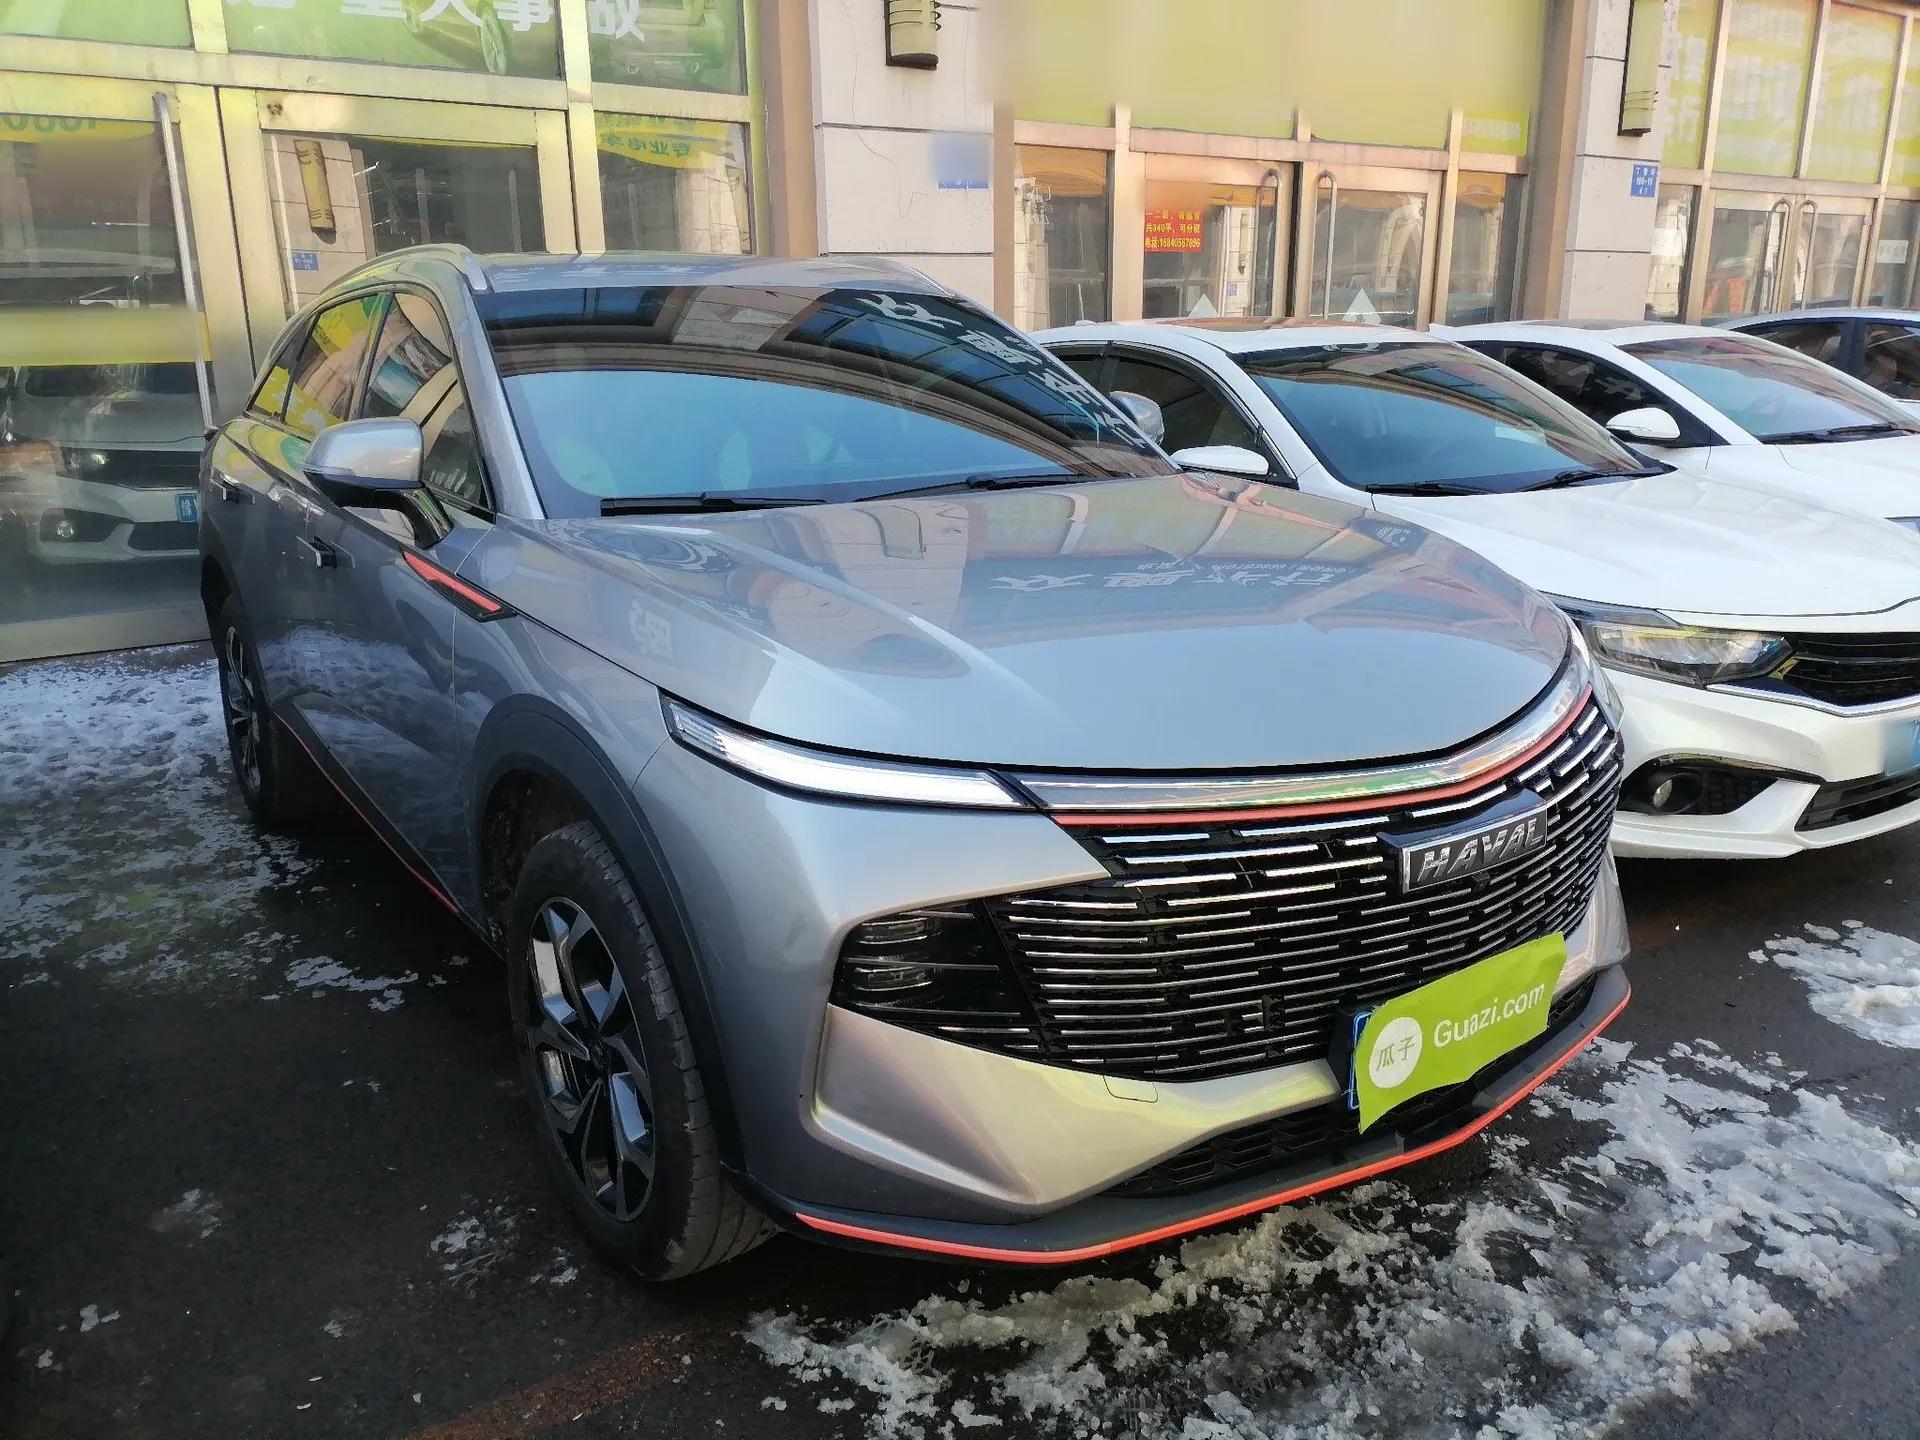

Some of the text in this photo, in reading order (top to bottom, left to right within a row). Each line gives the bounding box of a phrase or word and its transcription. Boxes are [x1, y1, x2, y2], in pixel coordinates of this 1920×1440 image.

[1418, 818, 1544, 881] HAVAL
[1434, 984, 1545, 1047] Guazi.com
[1376, 1032, 1417, 1073] 瓜子
